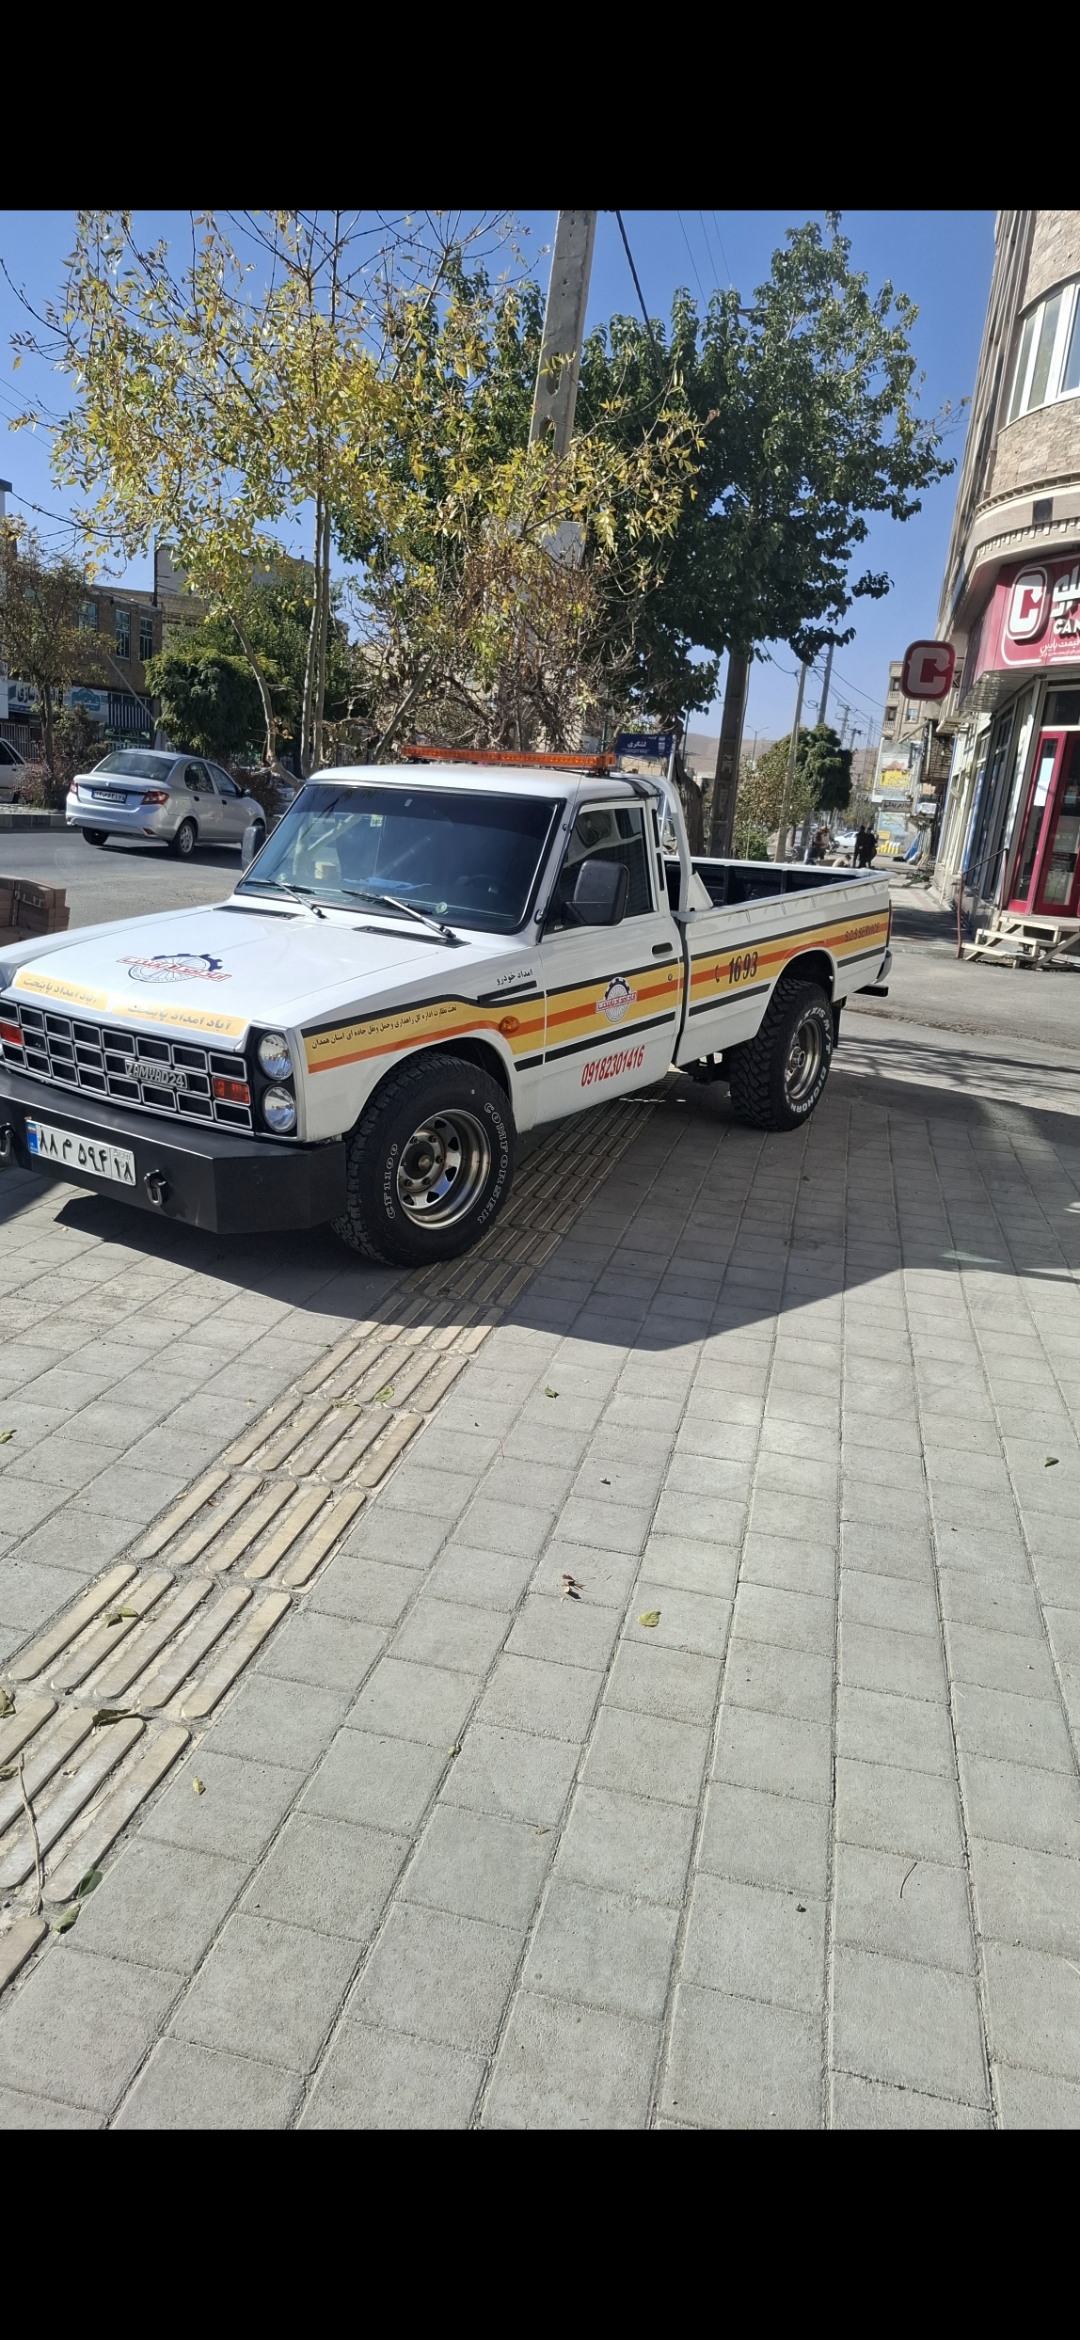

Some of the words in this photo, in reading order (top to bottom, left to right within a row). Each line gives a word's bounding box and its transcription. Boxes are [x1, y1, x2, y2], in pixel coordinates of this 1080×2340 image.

[496, 972, 516, 986] خودرو
[517, 968, 534, 979] امداد
[729, 951, 758, 985] 1693
[581, 1045, 645, 1087] 09182301416
